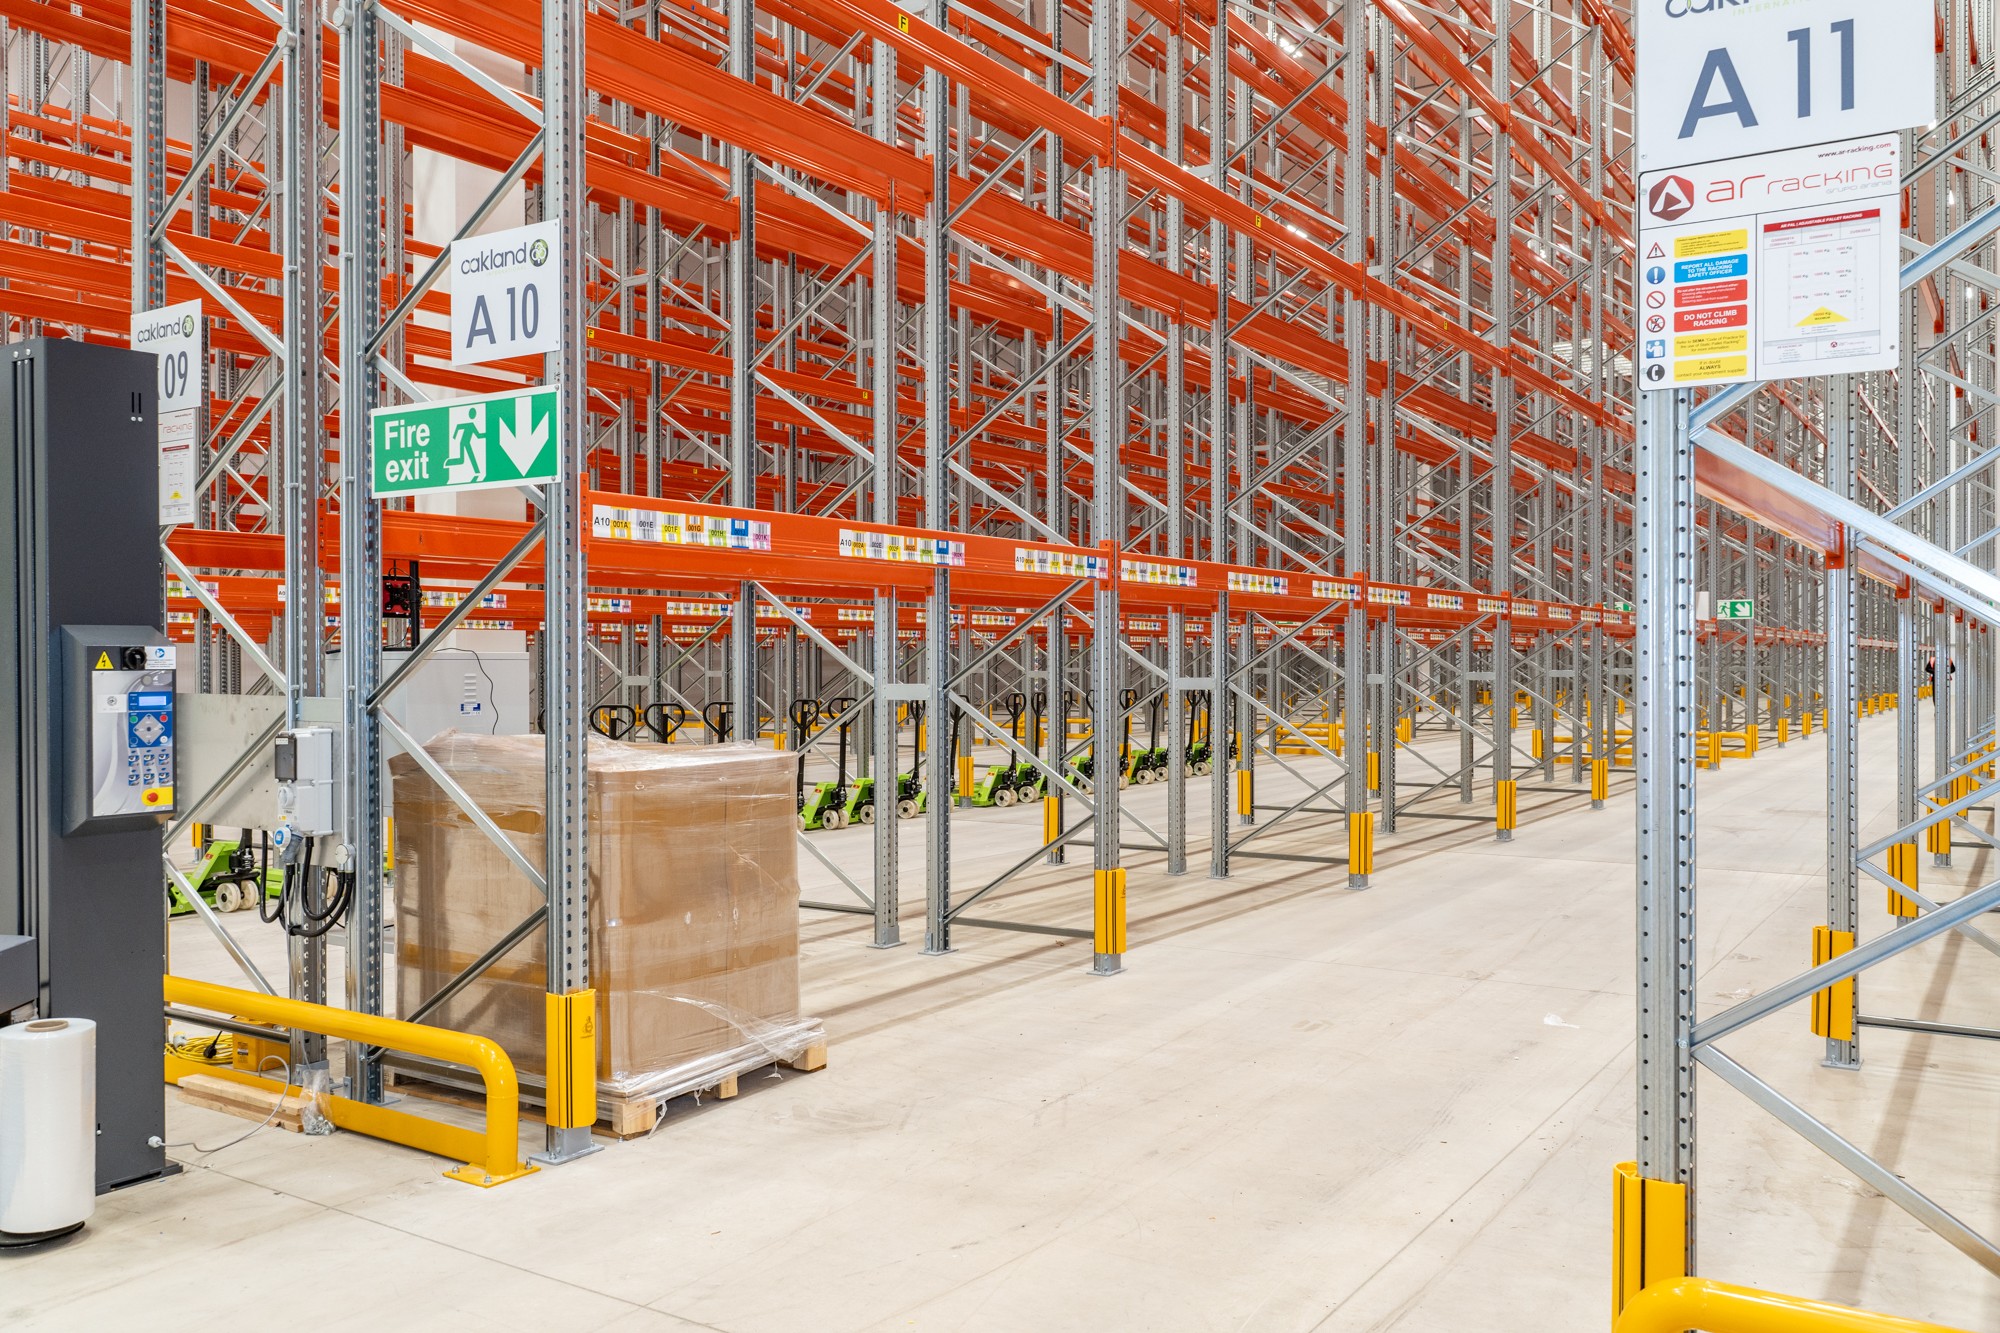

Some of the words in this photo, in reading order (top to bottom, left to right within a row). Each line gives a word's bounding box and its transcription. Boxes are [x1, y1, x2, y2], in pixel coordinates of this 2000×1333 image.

[900, 16, 906, 28] F
[1677, 47, 1759, 140] A
[1787, 18, 1854, 118] 11
[1818, 142, 1892, 159] www.ar-racking.com
[461, 242, 526, 275] oakland
[138, 317, 181, 344] oakland
[466, 295, 496, 348] A
[507, 283, 539, 341] 10
[1693, 318, 1727, 327] RACKING
[164, 350, 188, 399] 09
[384, 419, 430, 450] Fire
[385, 451, 429, 482] exit
[594, 516, 610, 526] A10
